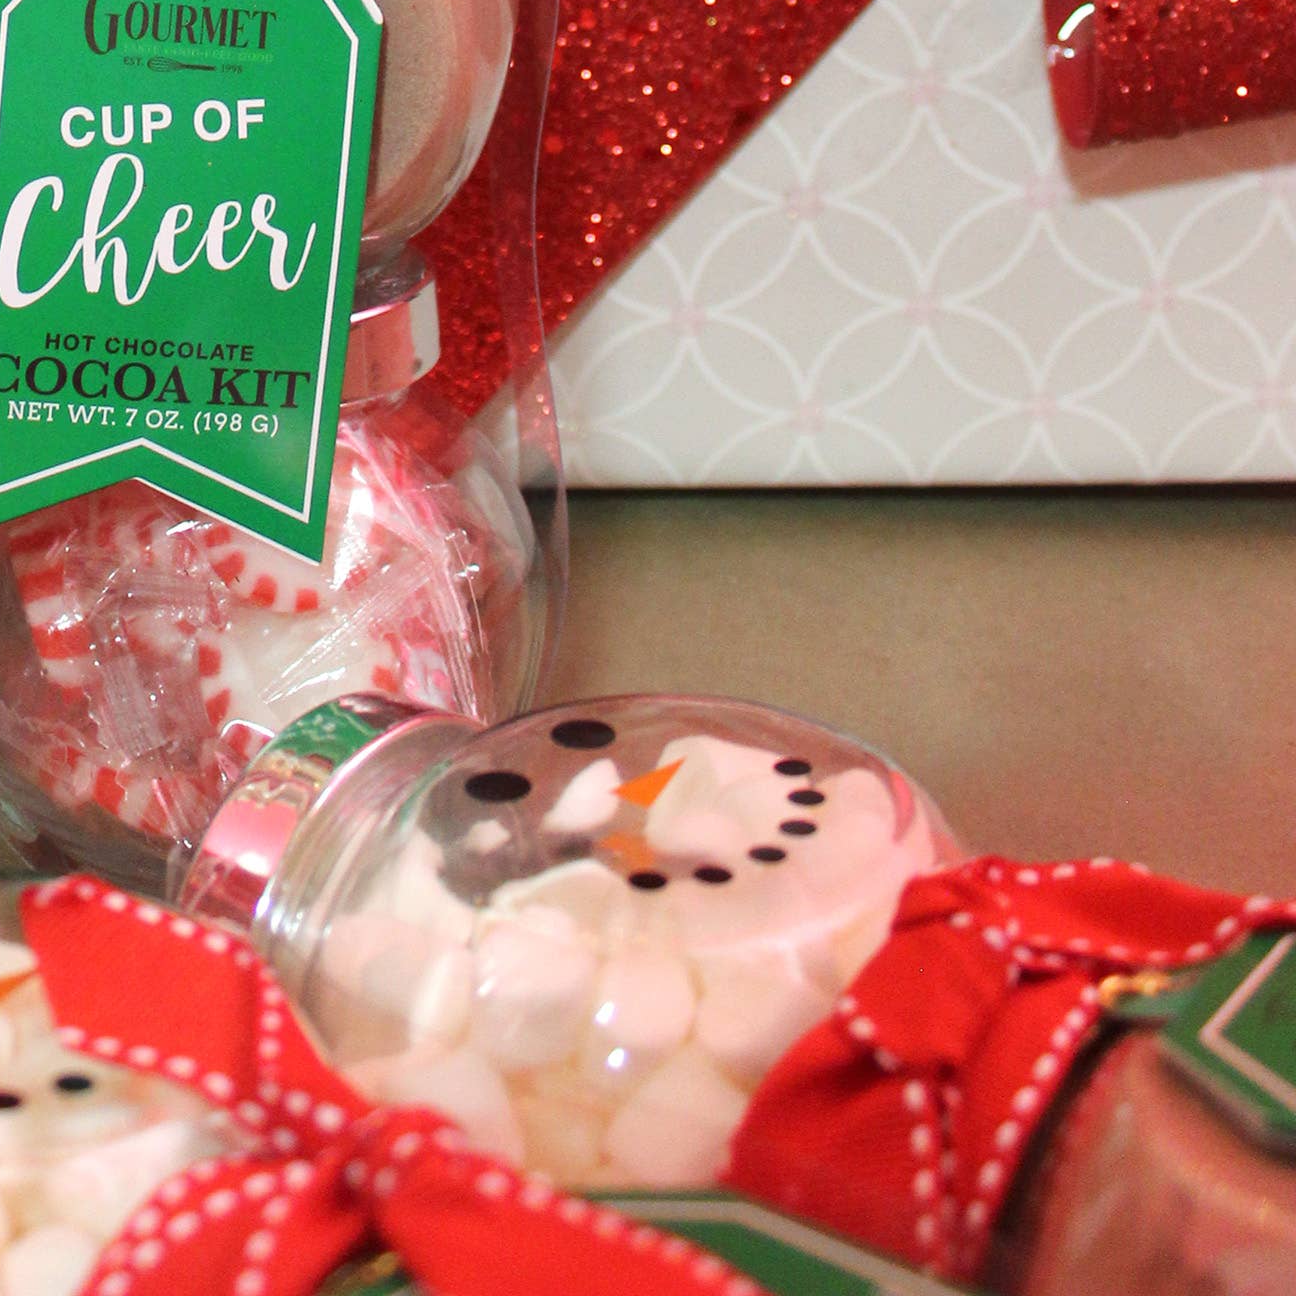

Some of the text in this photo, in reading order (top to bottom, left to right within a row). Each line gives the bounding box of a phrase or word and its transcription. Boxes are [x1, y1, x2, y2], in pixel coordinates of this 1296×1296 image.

[60, 98, 266, 148] CUP OF
[45, 332, 255, 362] HOT CHOCOLATE
[207, 367, 311, 408] KIT
[7, 400, 279, 437] NET WT. 7 OZ. (198 G)
